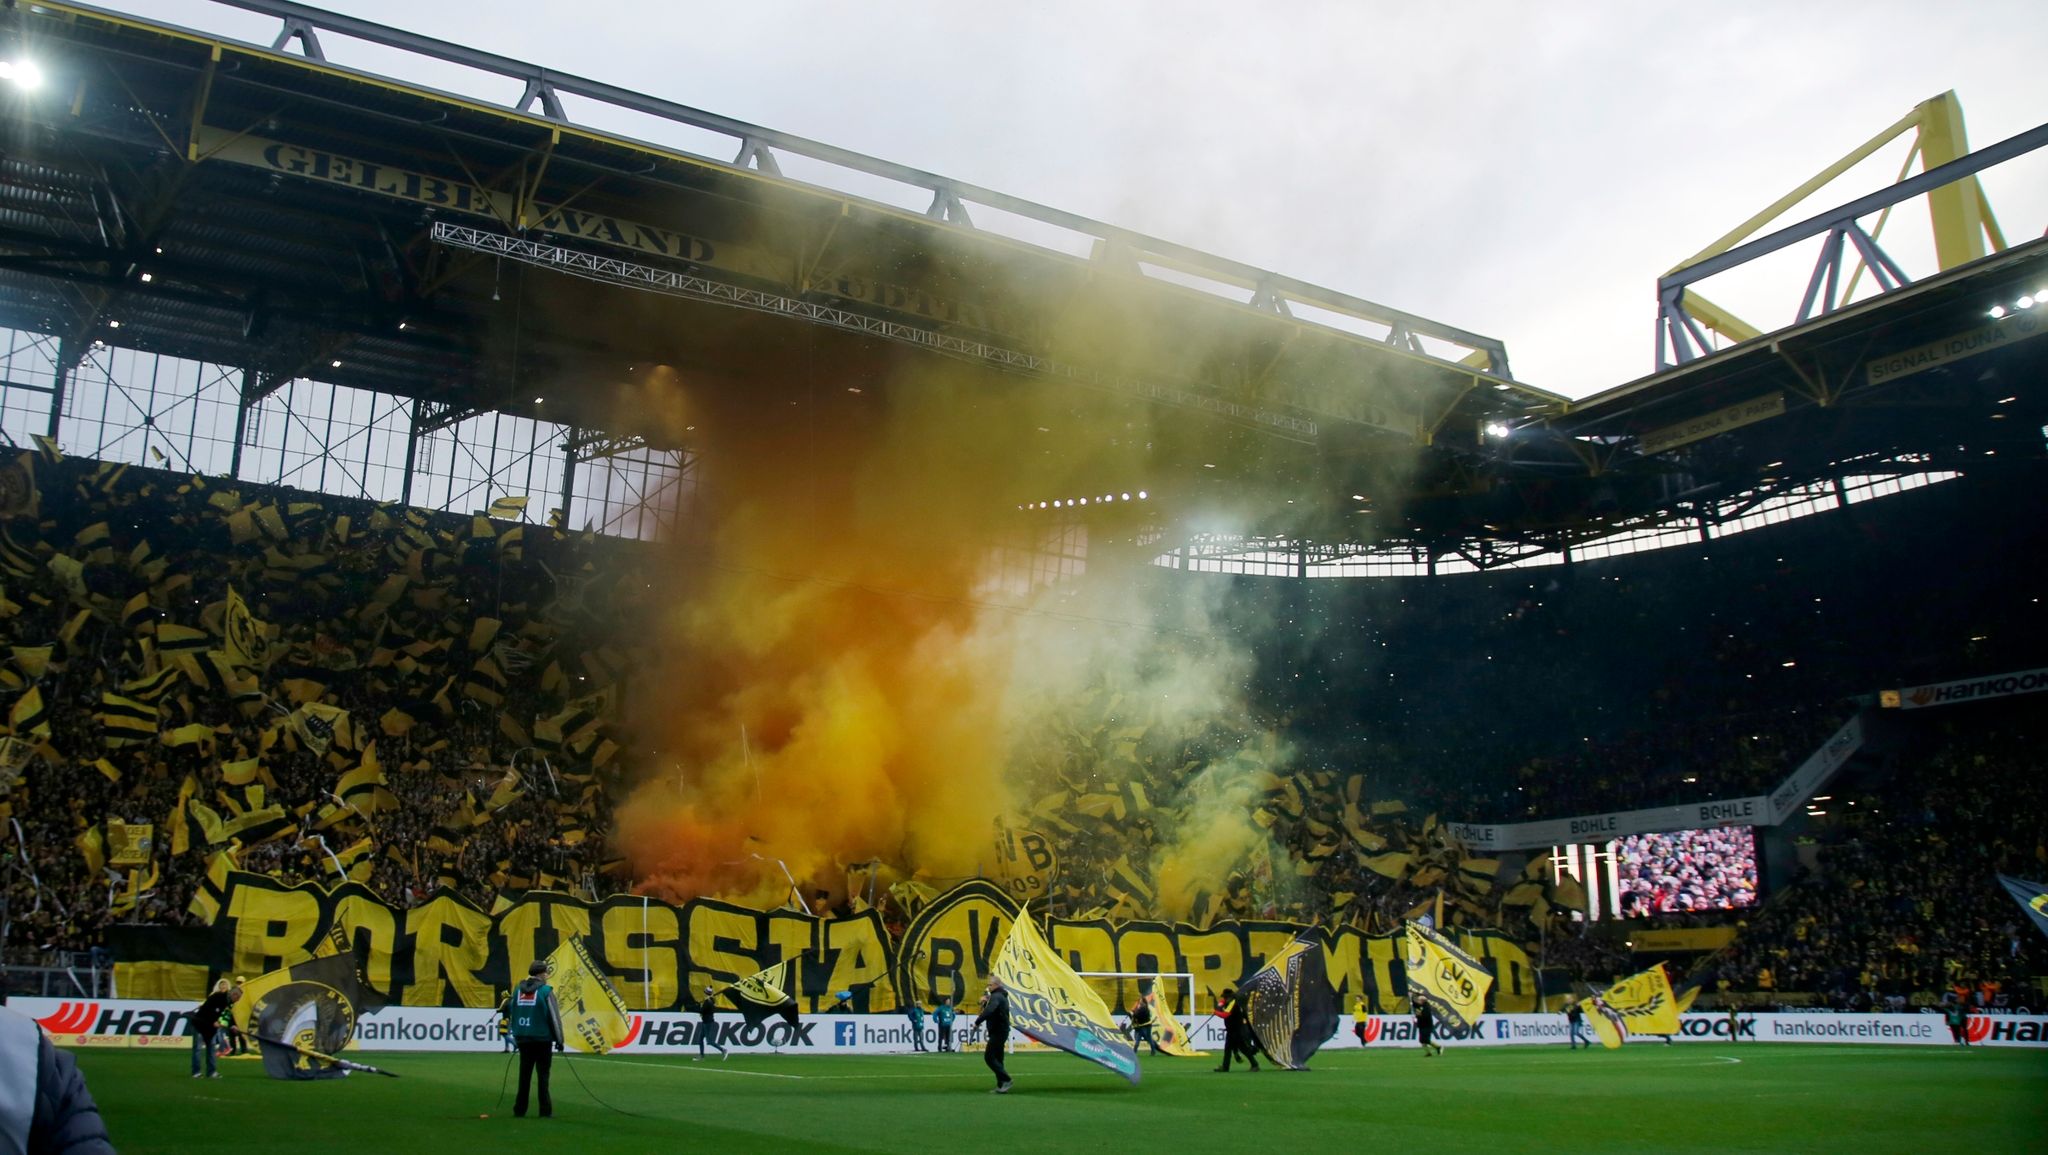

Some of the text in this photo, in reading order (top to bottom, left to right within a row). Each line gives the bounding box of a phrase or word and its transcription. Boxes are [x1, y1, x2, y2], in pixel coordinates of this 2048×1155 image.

[263, 143, 715, 262] GELBE WAND
[1871, 326, 2007, 379] SIGNAL IDUNA
[1687, 417, 1722, 435] IDUNA
[1745, 400, 1778, 418] PARK
[1570, 816, 1617, 834] BOHLE
[1699, 801, 1753, 821] BOHLE
[227, 884, 898, 1013] BORUSSIA
[928, 909, 1001, 1006] BV
[518, 1016, 531, 1027] 01
[1773, 1019, 1933, 1038] hankookreifen.de
